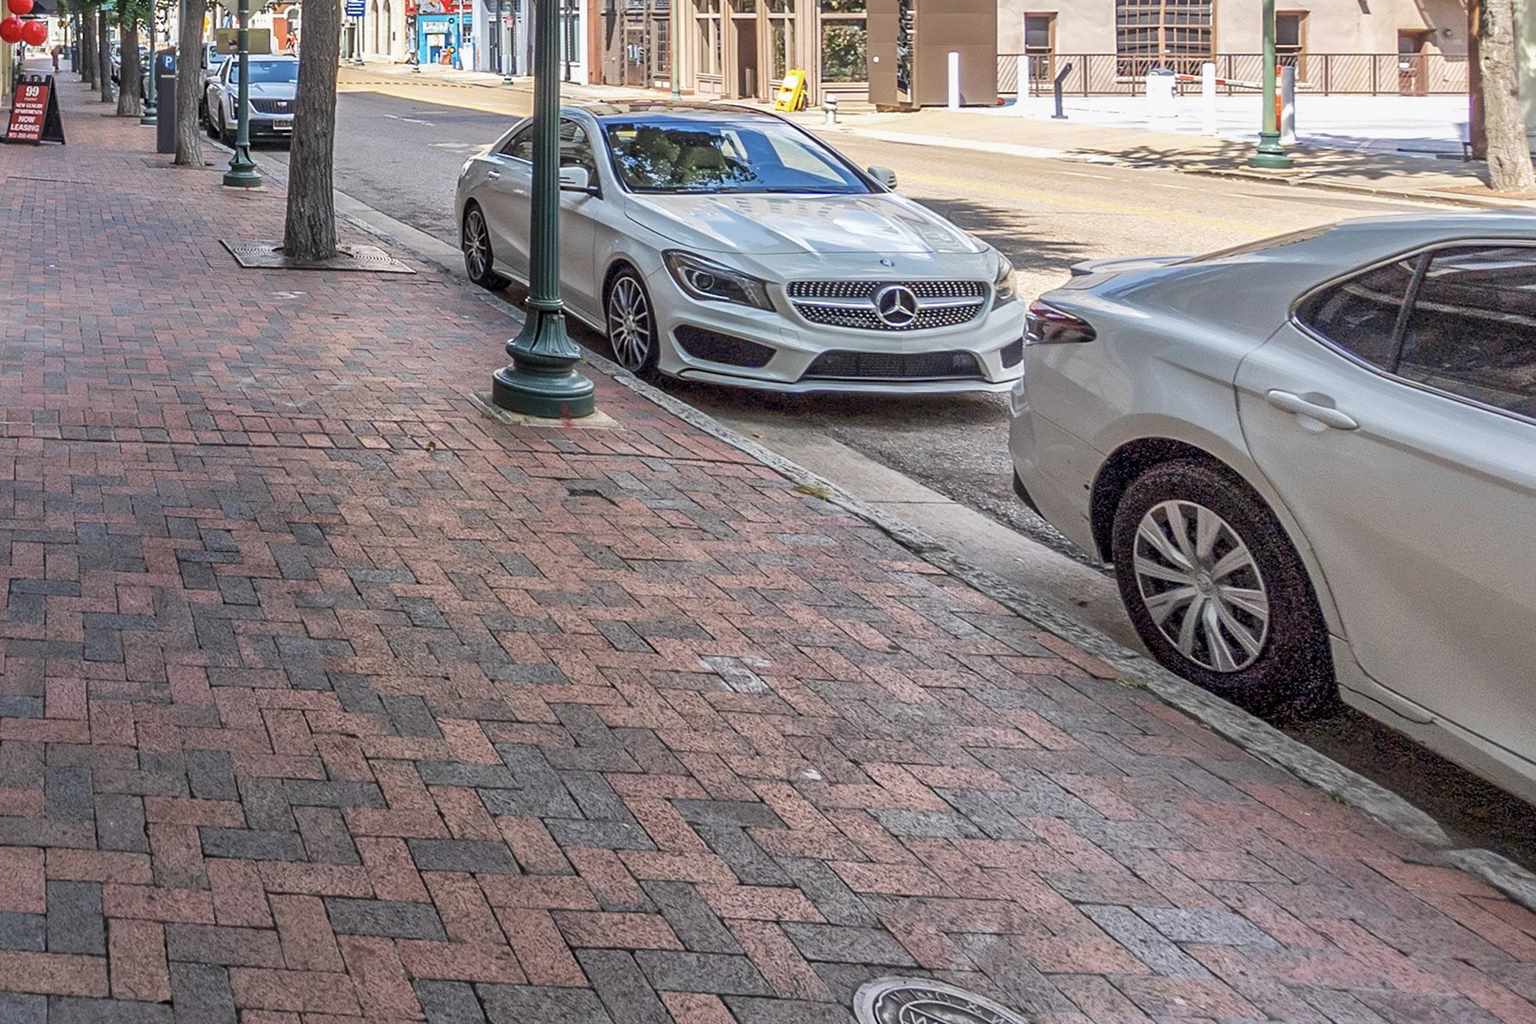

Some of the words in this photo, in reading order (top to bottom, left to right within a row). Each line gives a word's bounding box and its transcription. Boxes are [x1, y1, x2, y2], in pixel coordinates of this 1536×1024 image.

[165, 55, 173, 68] P
[25, 86, 39, 97] 99
[17, 115, 36, 123] NOW
[10, 123, 41, 133] LEASING
